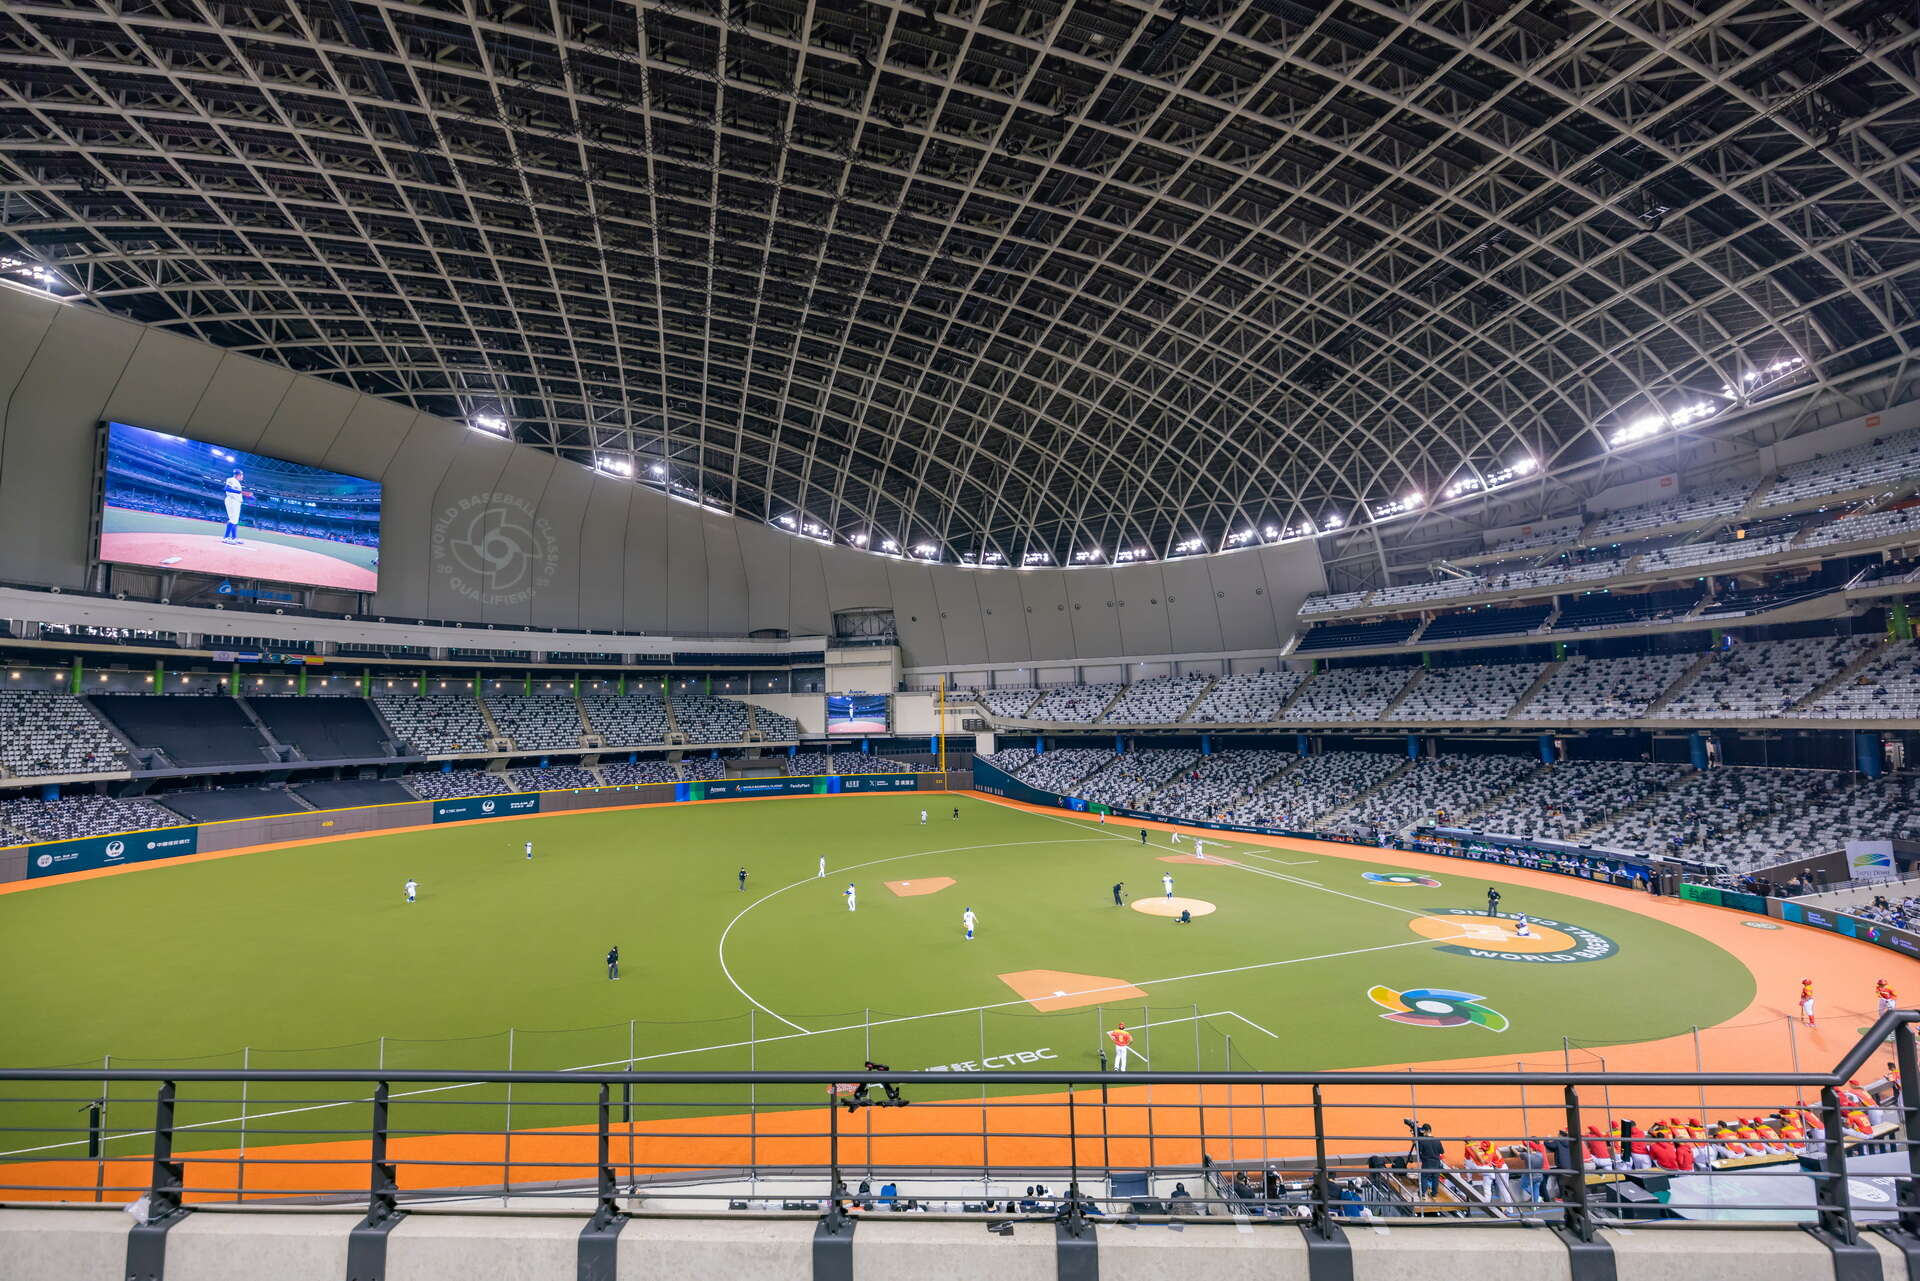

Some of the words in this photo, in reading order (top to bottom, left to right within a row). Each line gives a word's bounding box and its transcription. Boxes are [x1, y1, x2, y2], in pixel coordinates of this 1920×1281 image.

[432, 507, 458, 560] WORLD
[458, 492, 536, 519] BASEBALL
[534, 518, 559, 576] CLASSIC
[449, 577, 537, 605] QUALIFIERS
[1469, 949, 1576, 962] WORLD
[1564, 926, 1610, 959] BASEBALL
[983, 1048, 1058, 1069] CTBC
